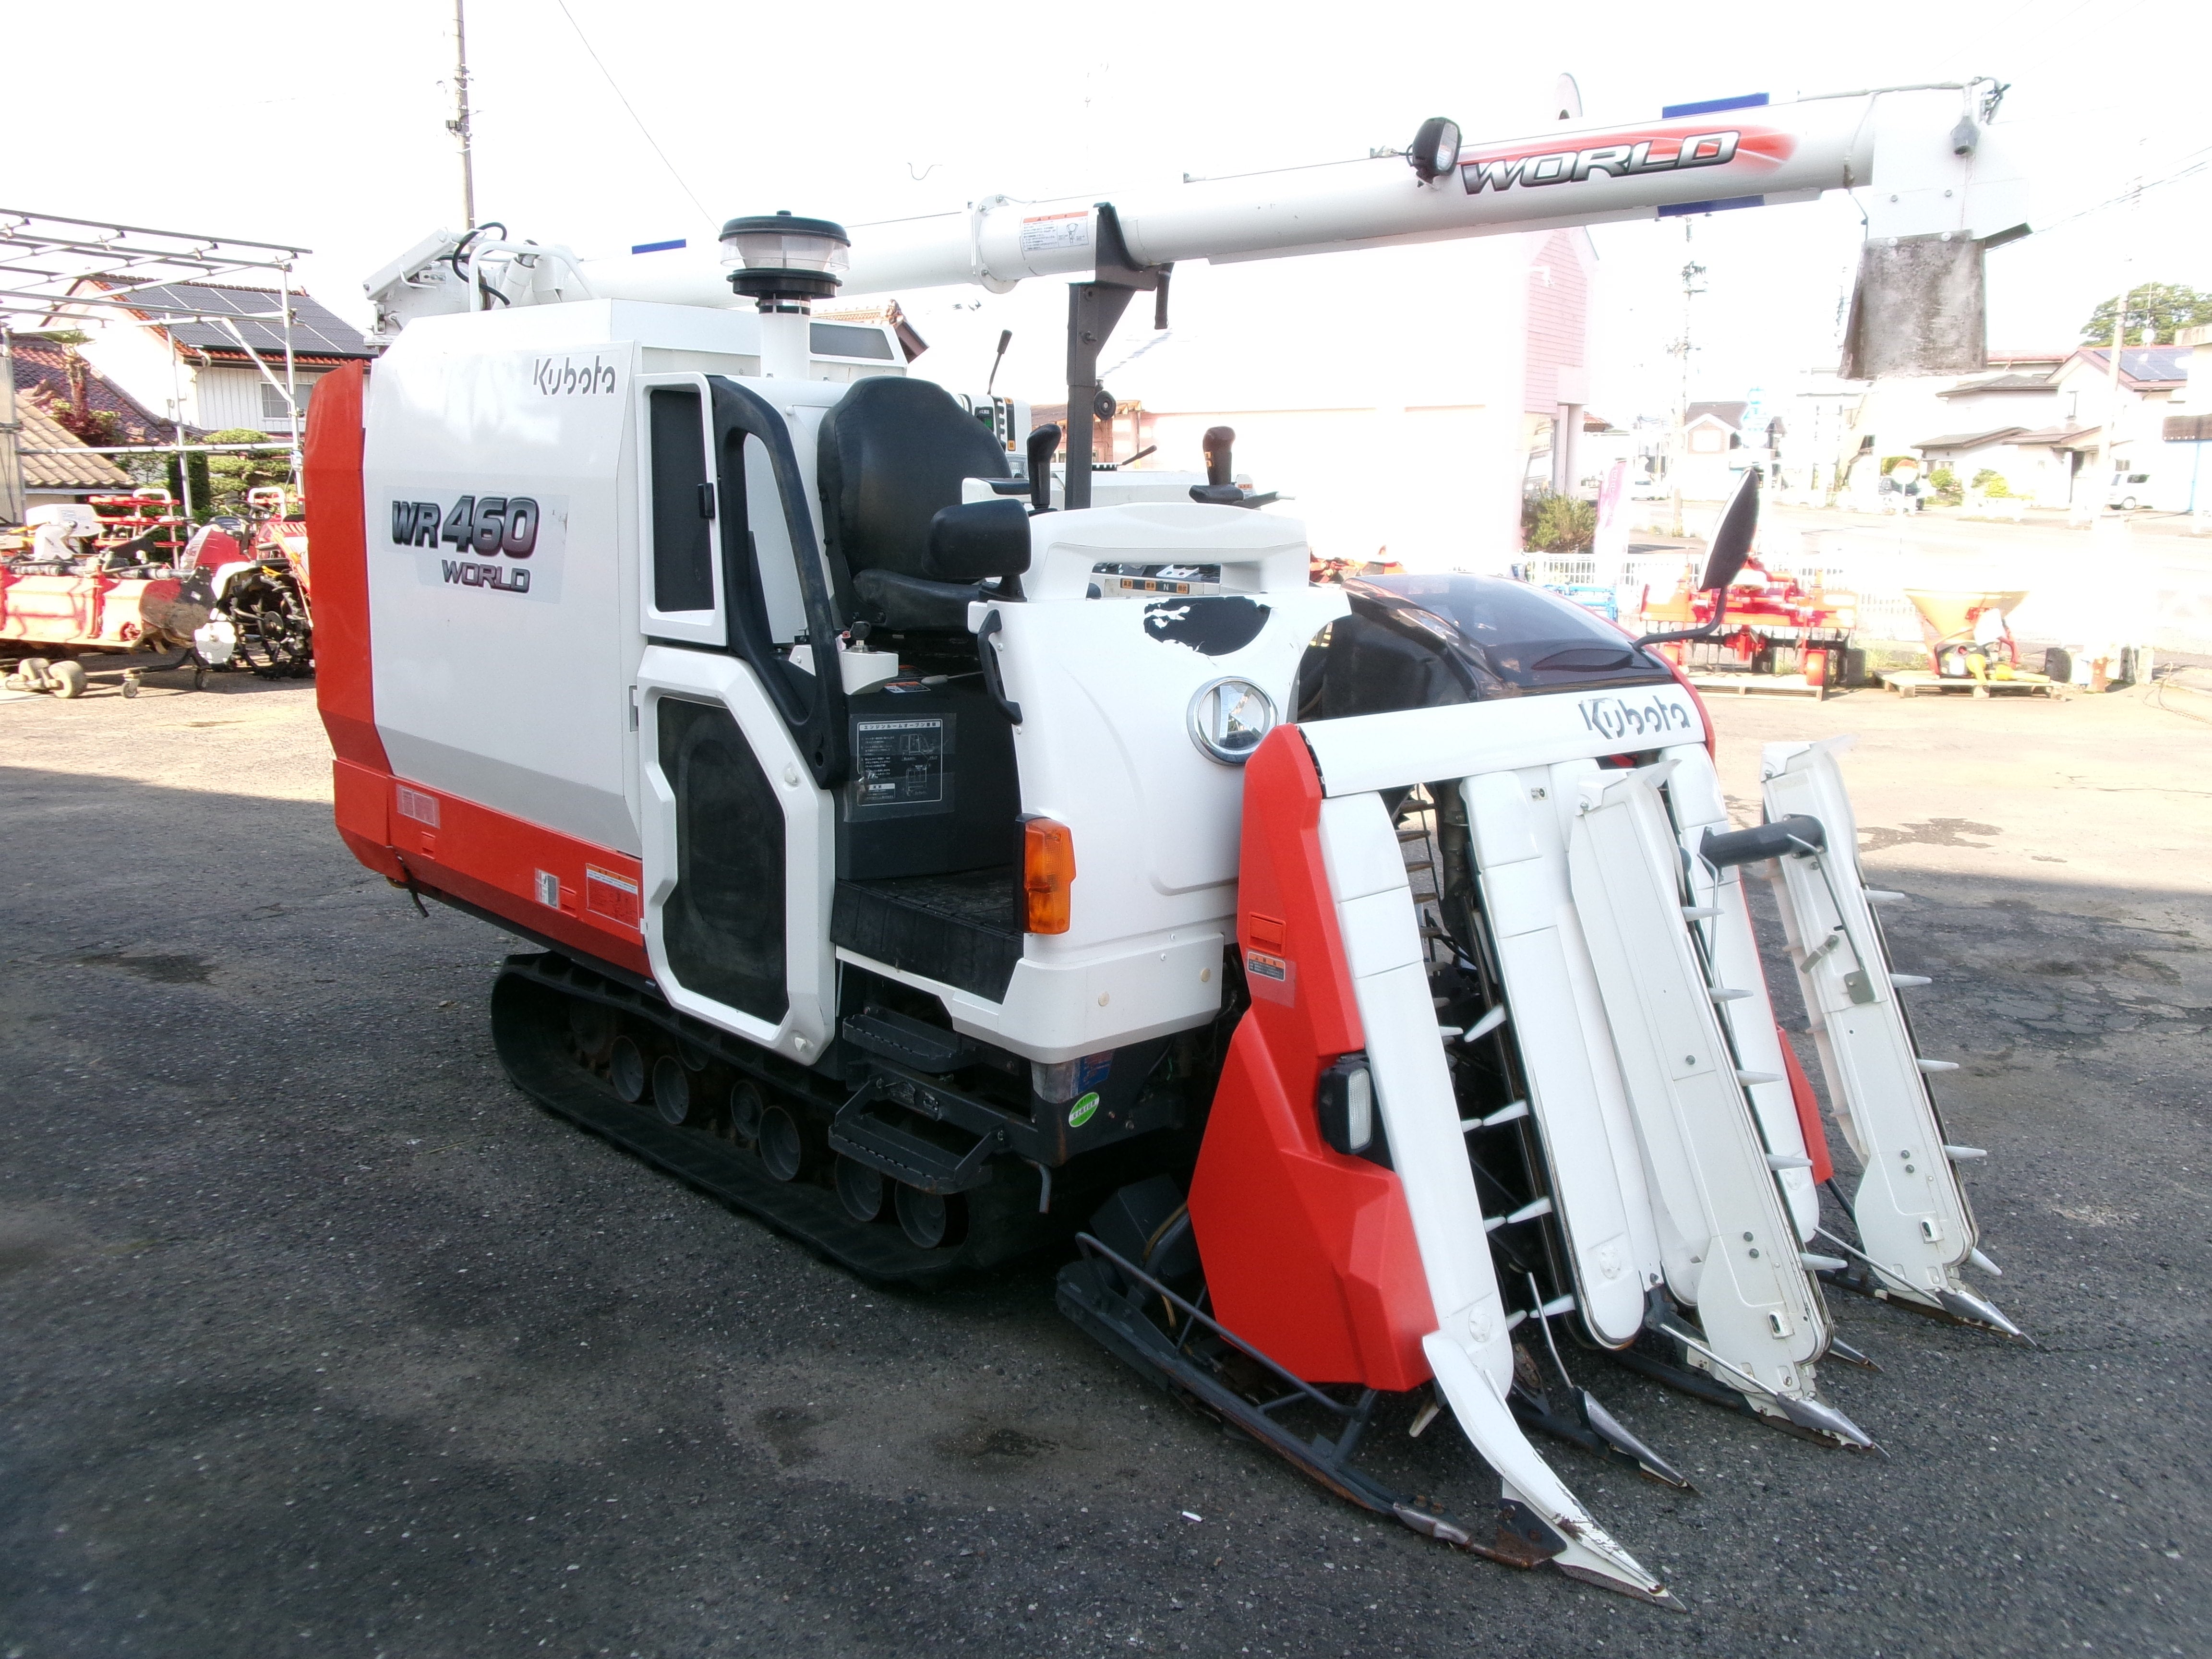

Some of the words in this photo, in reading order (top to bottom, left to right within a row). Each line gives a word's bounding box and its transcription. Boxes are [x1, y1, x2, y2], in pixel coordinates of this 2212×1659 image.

[1461, 130, 1741, 195] WORLD
[533, 355, 616, 396] Kubota
[442, 559, 530, 594] WORLD
[1578, 695, 1691, 740] Kubota
